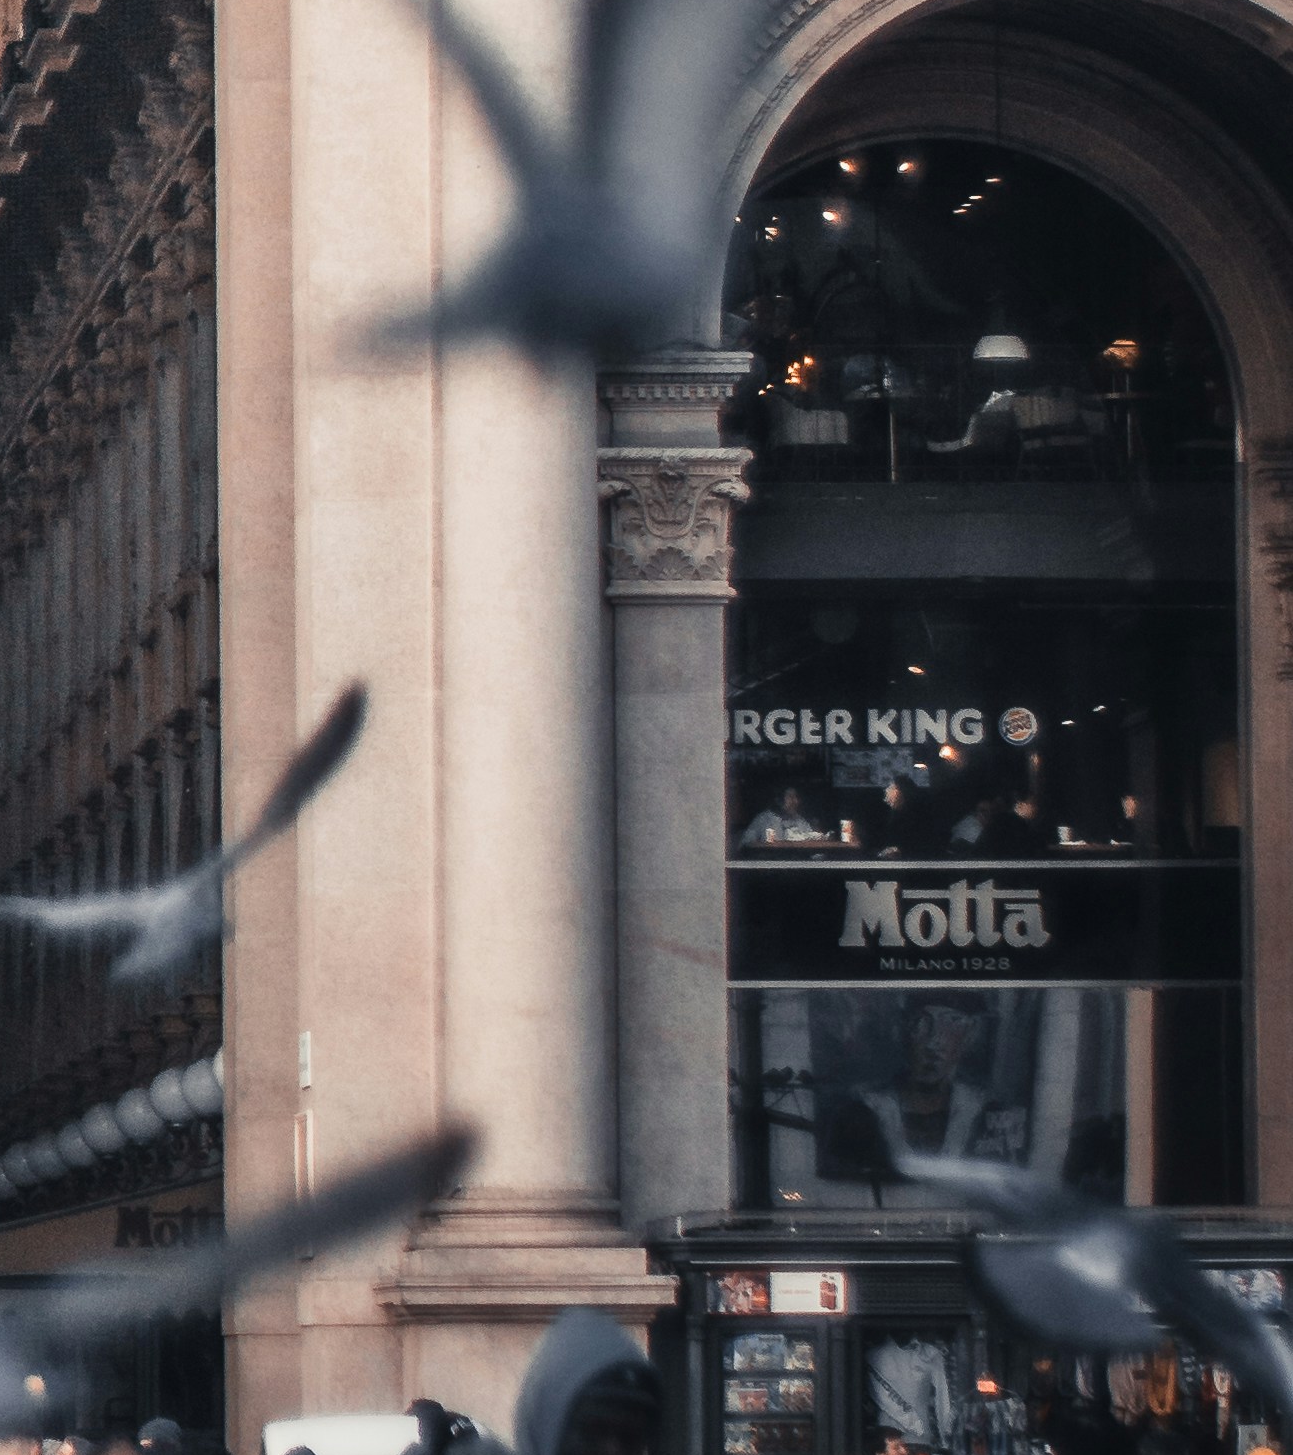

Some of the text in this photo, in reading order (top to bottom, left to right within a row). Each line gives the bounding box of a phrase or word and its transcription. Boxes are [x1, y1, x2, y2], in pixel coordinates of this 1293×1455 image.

[726, 708, 854, 745] RGER
[867, 708, 985, 745] KING
[838, 879, 1051, 949] Motta
[879, 956, 1012, 972] MILANO 1928
[114, 1202, 223, 1248] Mott
